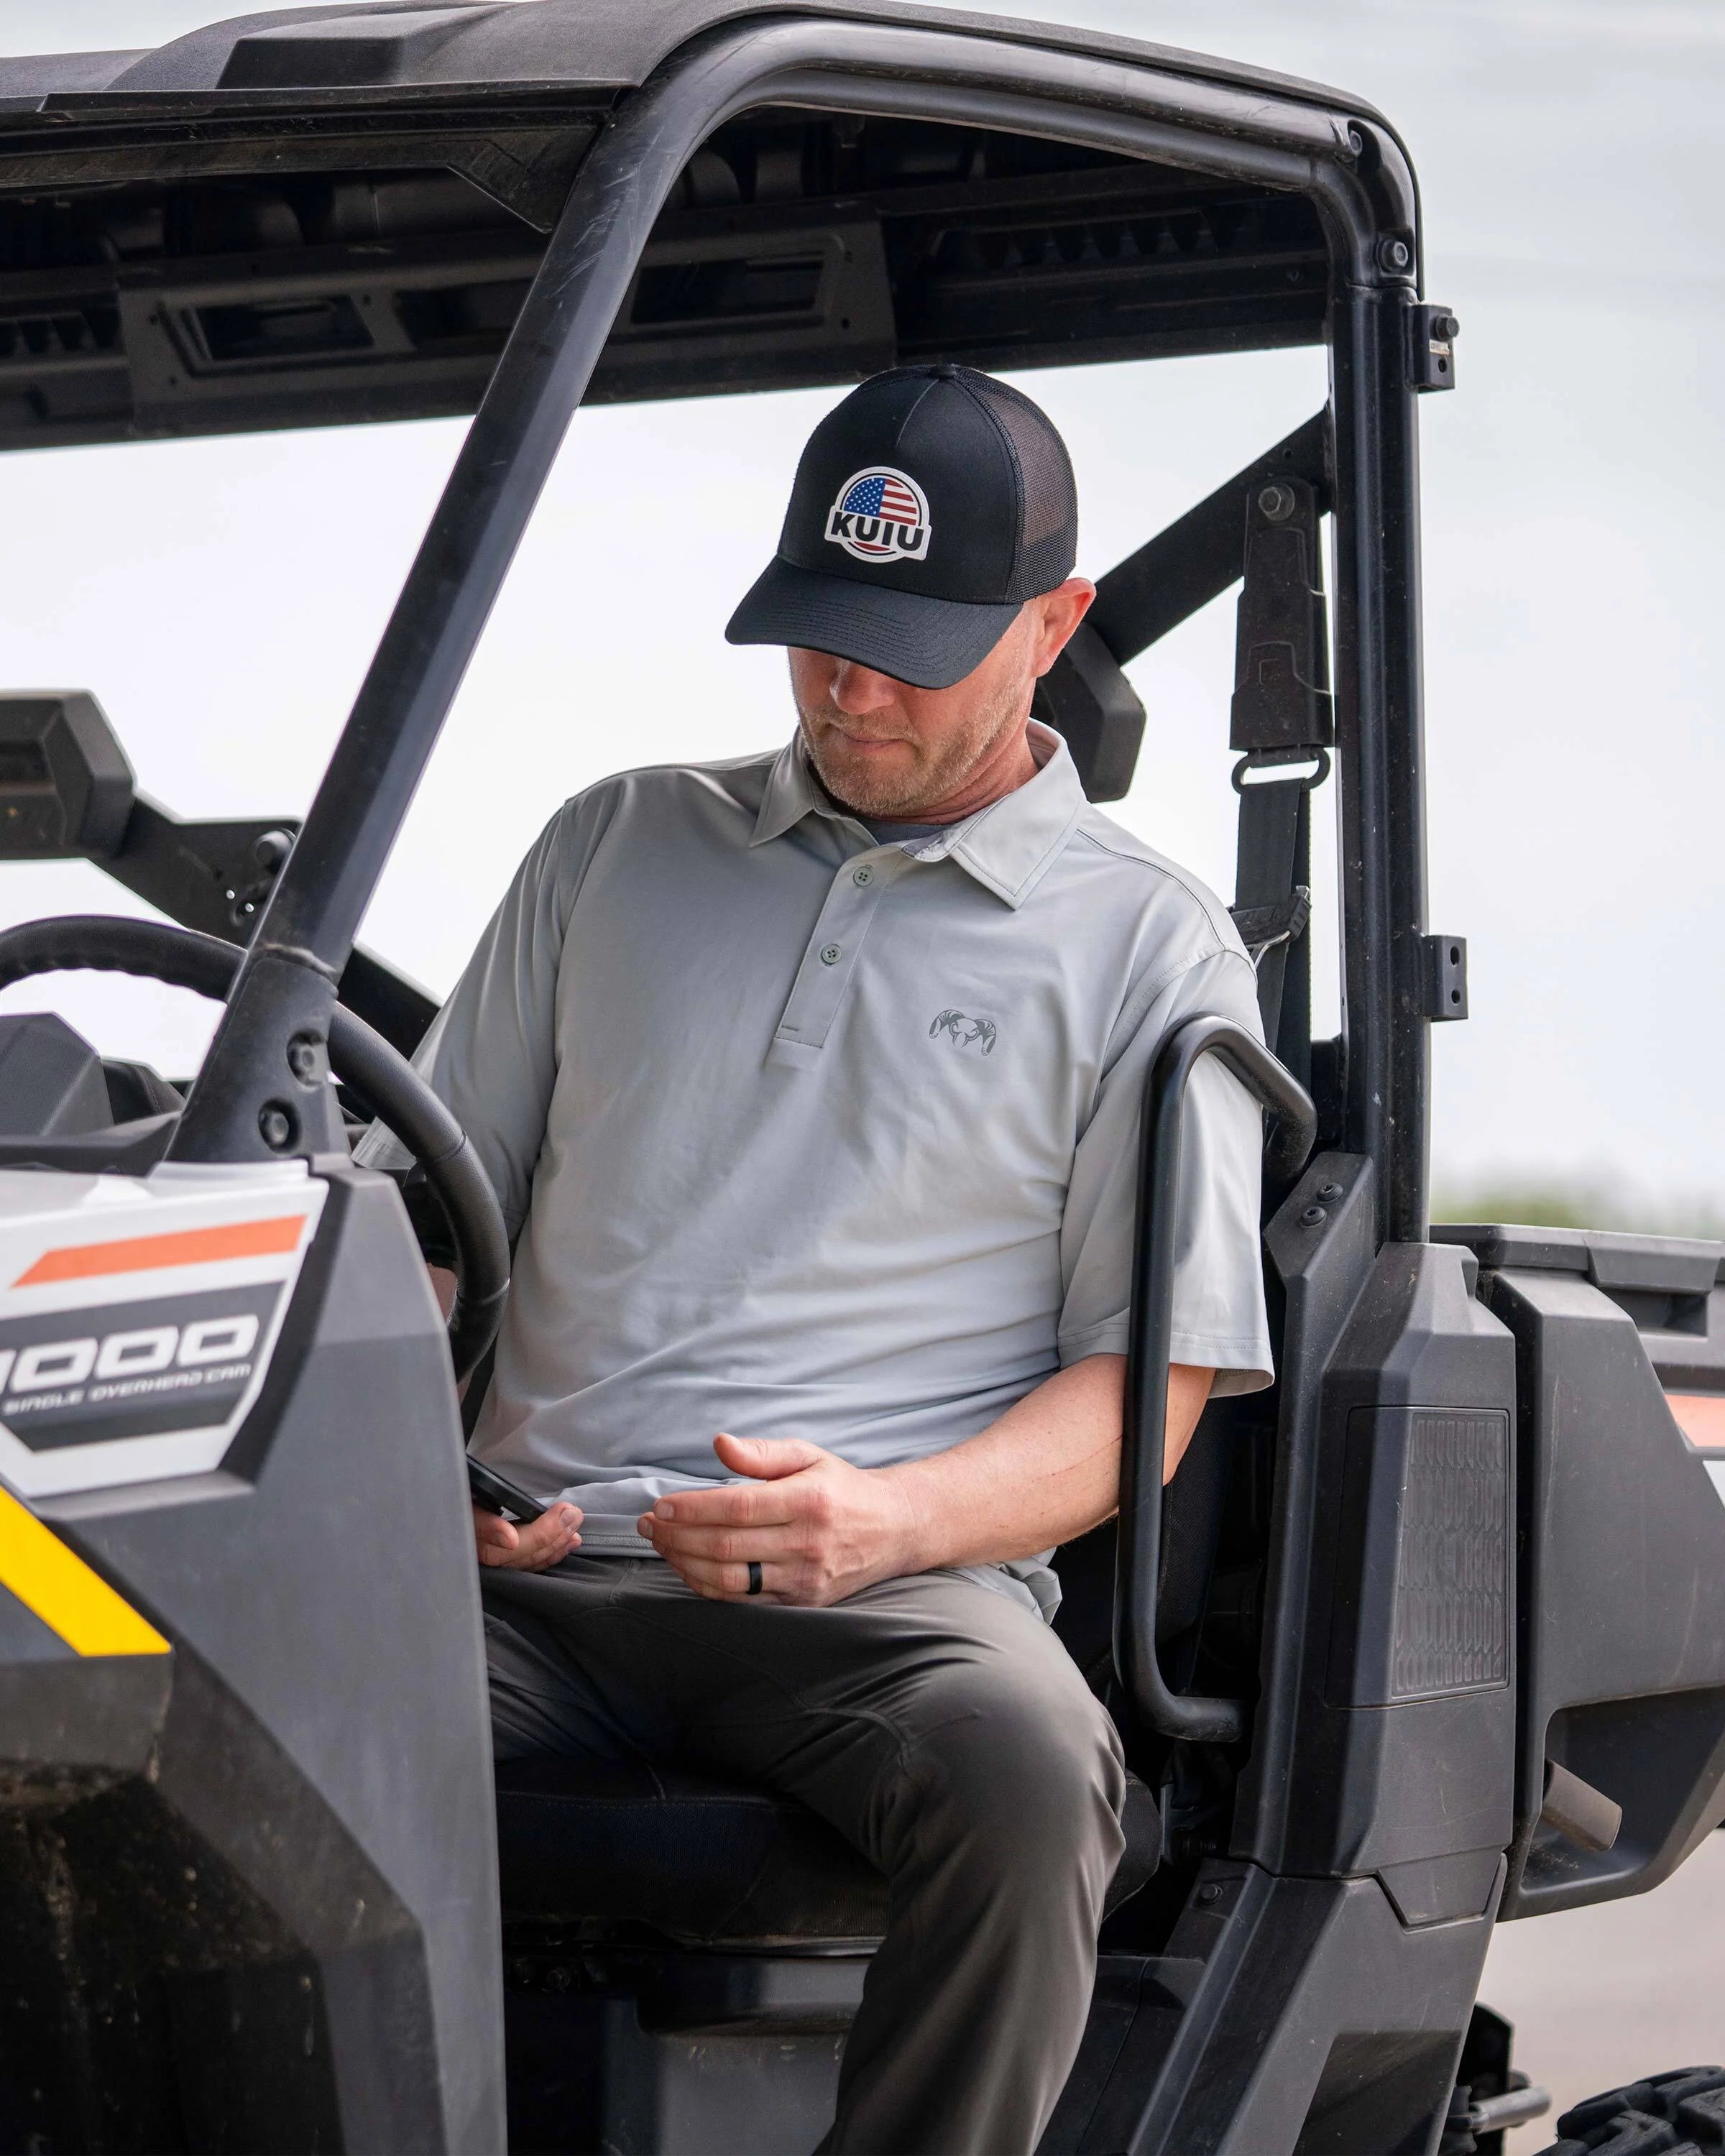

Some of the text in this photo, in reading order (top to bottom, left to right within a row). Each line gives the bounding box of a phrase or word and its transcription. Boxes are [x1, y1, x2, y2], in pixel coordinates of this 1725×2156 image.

[831, 511, 924, 551] KUIU
[3, 1363, 252, 1416] SINGLE OVERHEAD CAM
